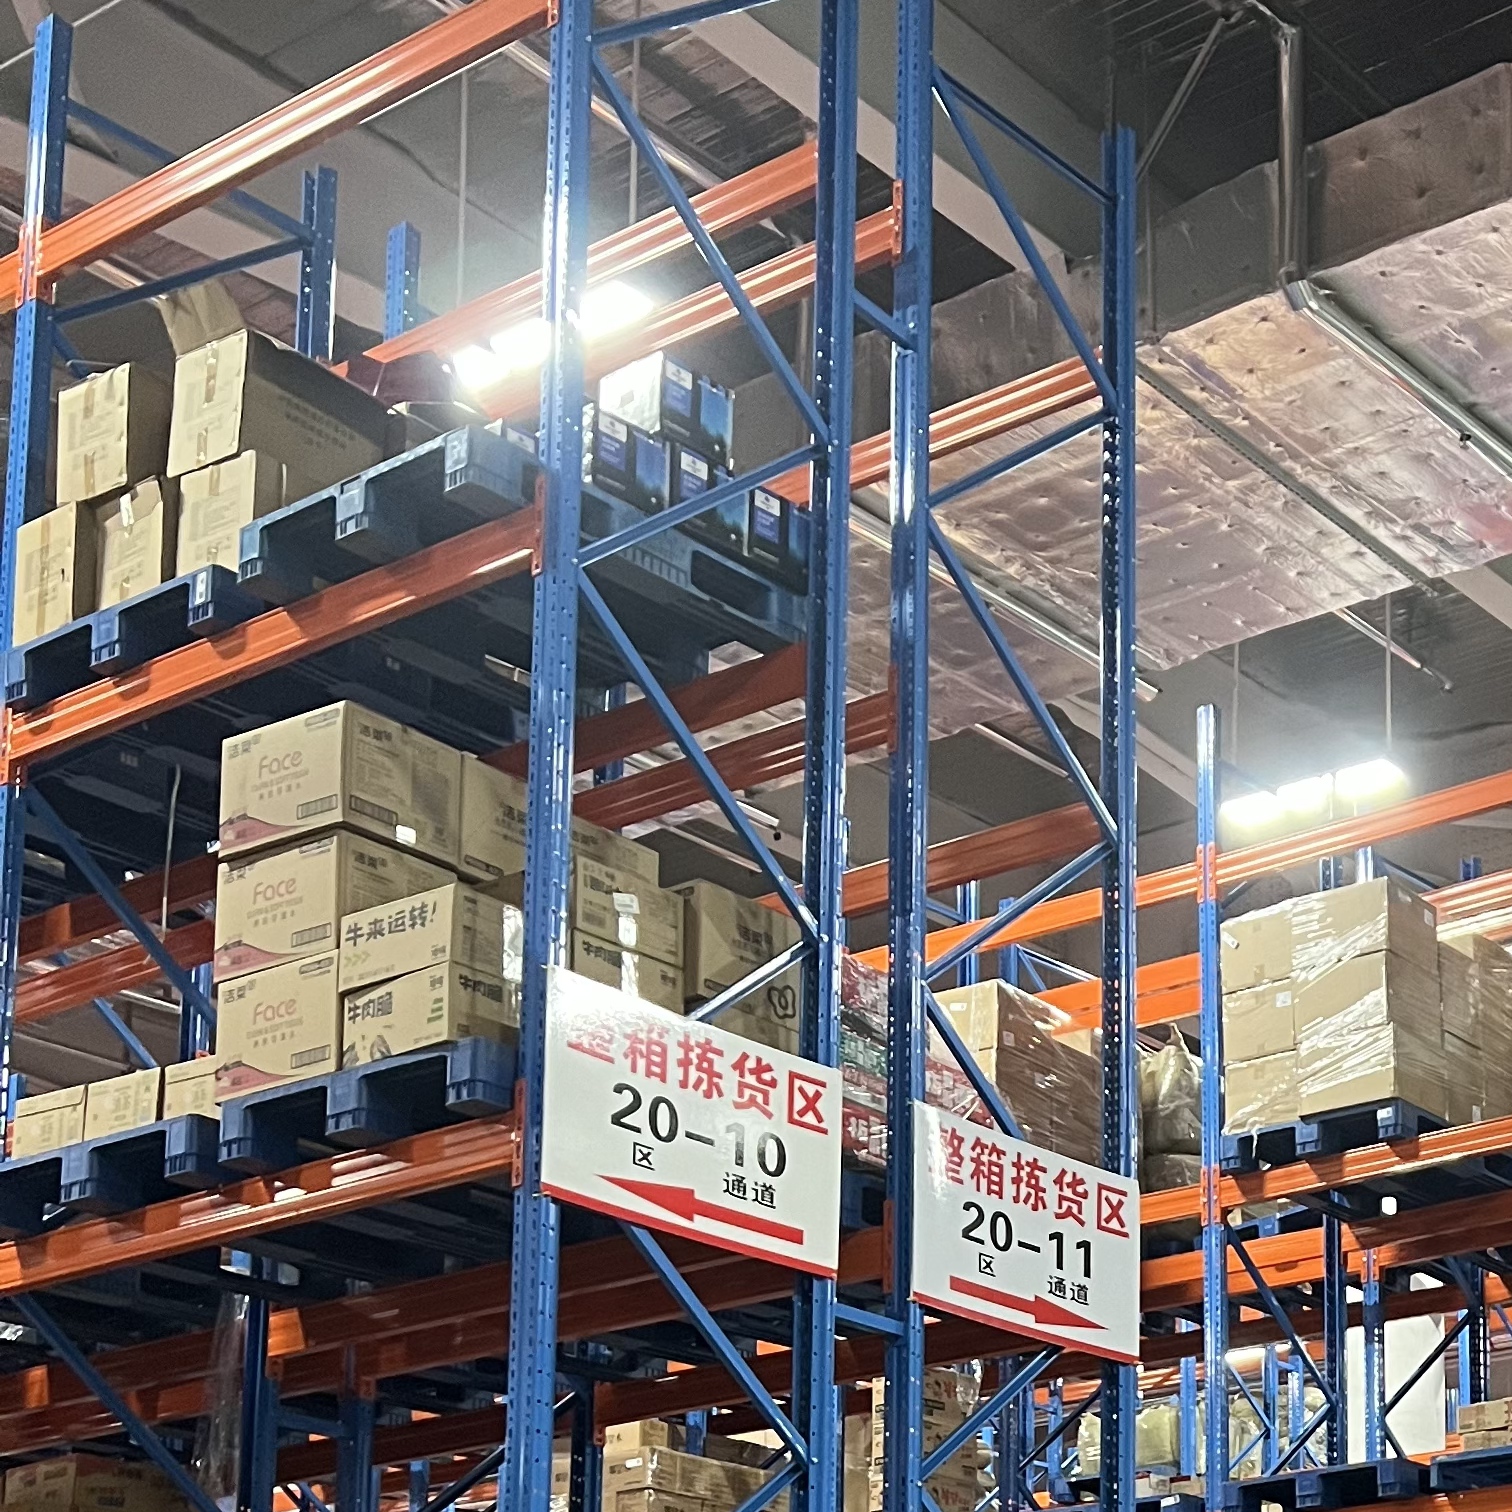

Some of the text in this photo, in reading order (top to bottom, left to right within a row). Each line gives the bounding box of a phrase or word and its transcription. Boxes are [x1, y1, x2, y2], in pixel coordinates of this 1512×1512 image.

[258, 751, 303, 779] Face
[252, 877, 297, 905] Face
[345, 901, 437, 947] 牛来运转!
[253, 998, 297, 1025] Face
[567, 1022, 829, 1135] 整箱拣货区
[611, 1082, 787, 1178] 20-10
[633, 1142, 655, 1171] 区
[723, 1171, 777, 1210] 通道
[935, 1125, 1129, 1239] 整箱拣货区
[961, 1201, 1092, 1279] 20-11
[978, 1253, 995, 1276] 区
[1047, 1275, 1089, 1305] 通道
